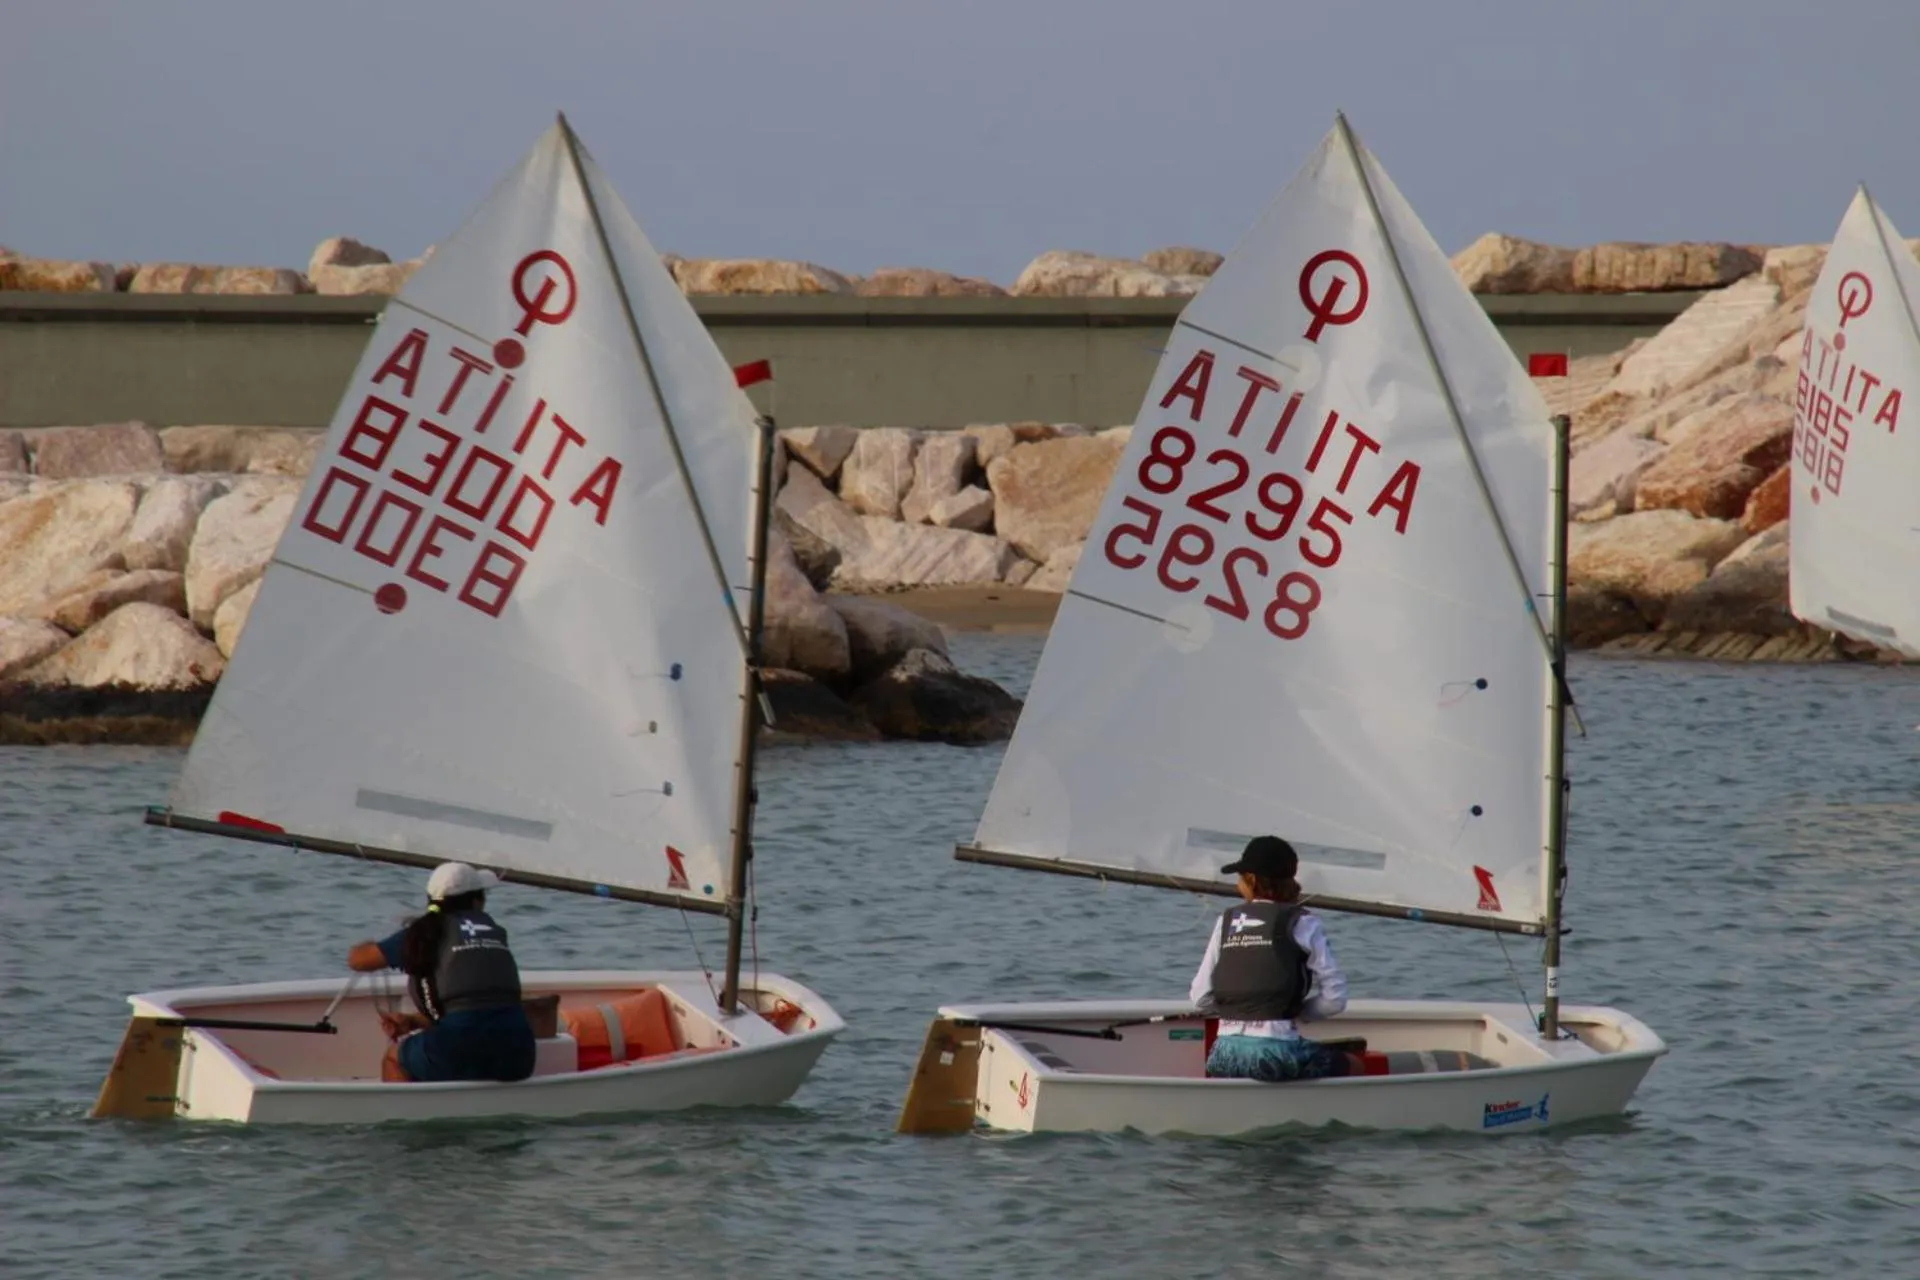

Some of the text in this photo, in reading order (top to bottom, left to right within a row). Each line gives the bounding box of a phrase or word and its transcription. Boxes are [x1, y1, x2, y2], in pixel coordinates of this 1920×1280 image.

[513, 398, 623, 527] ITA
[1796, 370, 1853, 452] 8185
[1843, 364, 1903, 434] ITA
[339, 395, 556, 551] 8300
[1138, 425, 1355, 569] 8295
[1304, 409, 1423, 535] ITA
